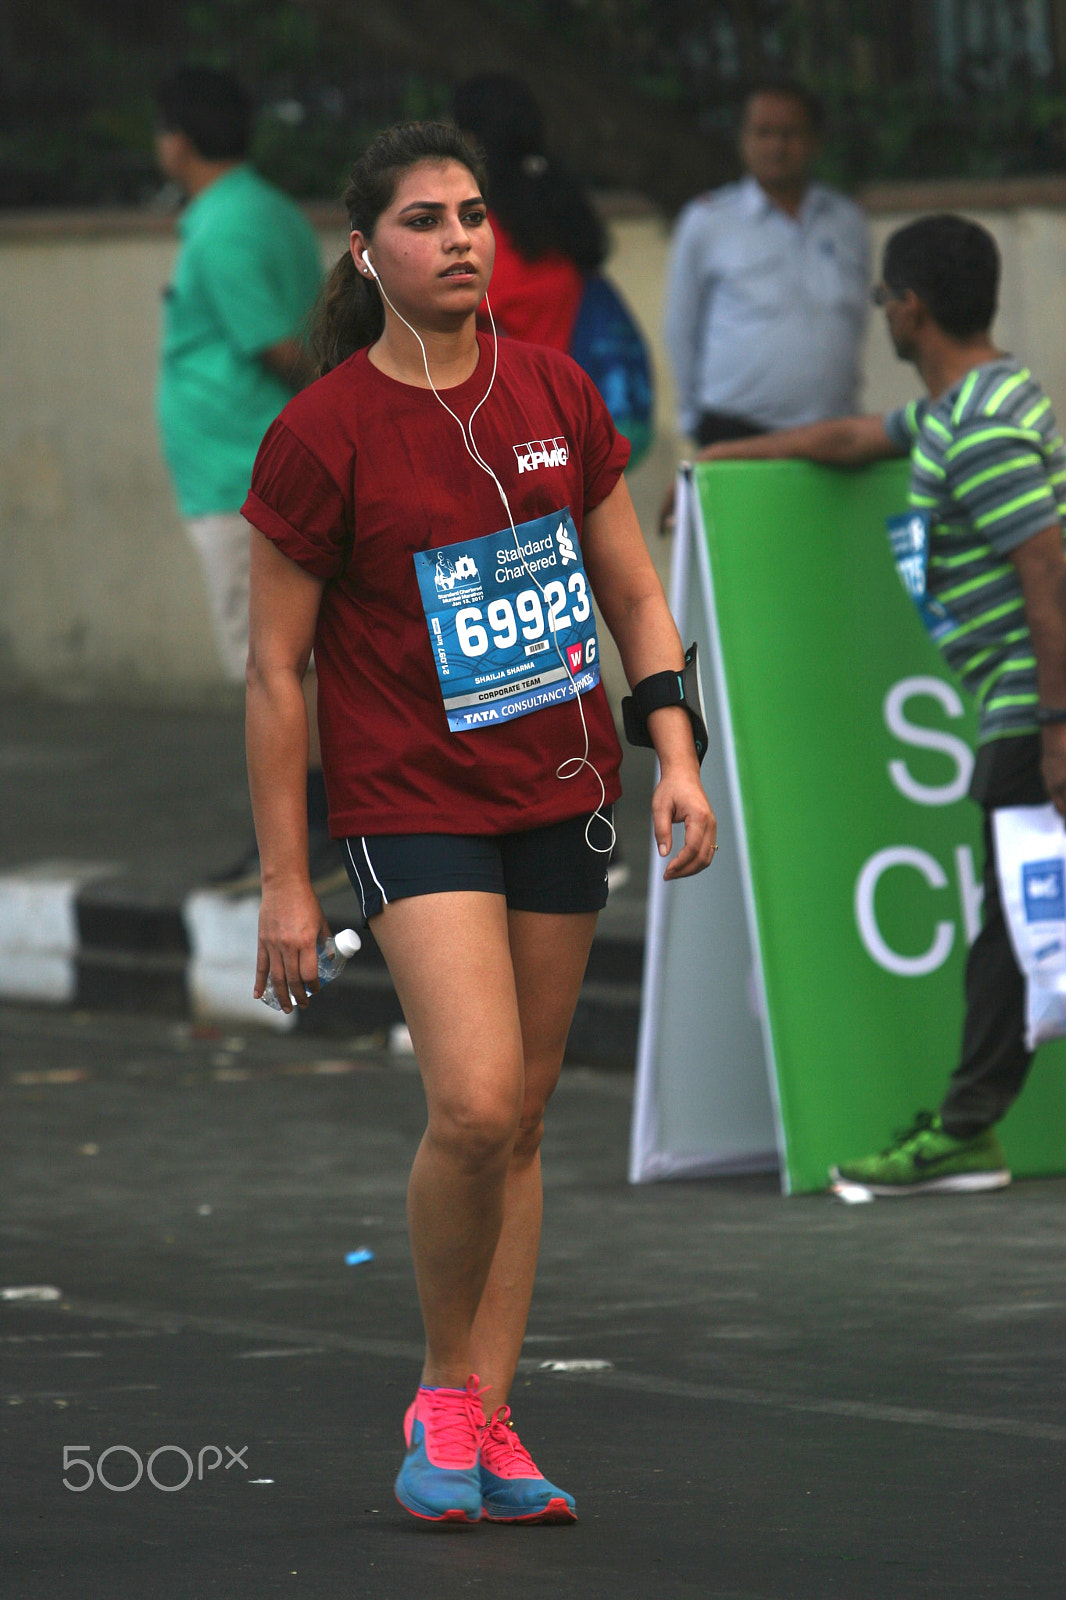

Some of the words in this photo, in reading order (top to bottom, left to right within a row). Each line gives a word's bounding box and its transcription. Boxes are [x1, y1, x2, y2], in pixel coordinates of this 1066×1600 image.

[515, 441, 569, 474] KPMG
[496, 534, 553, 564] Standard
[495, 551, 557, 583] Chartered
[438, 590, 459, 599] Standard
[459, 585, 483, 595] Chartered
[442, 595, 460, 604] Mumbai
[461, 590, 484, 599] Marathon
[472, 594, 485, 602] 2017
[455, 572, 591, 657] 69923
[437, 635, 444, 646] km
[474, 669, 506, 685] SHAILJA
[506, 661, 536, 676] SHARMA
[478, 684, 521, 701] CORPORATE
[521, 677, 542, 689] TEAM
[463, 709, 500, 725] TATA
[501, 686, 567, 717] CONSULTANCY
